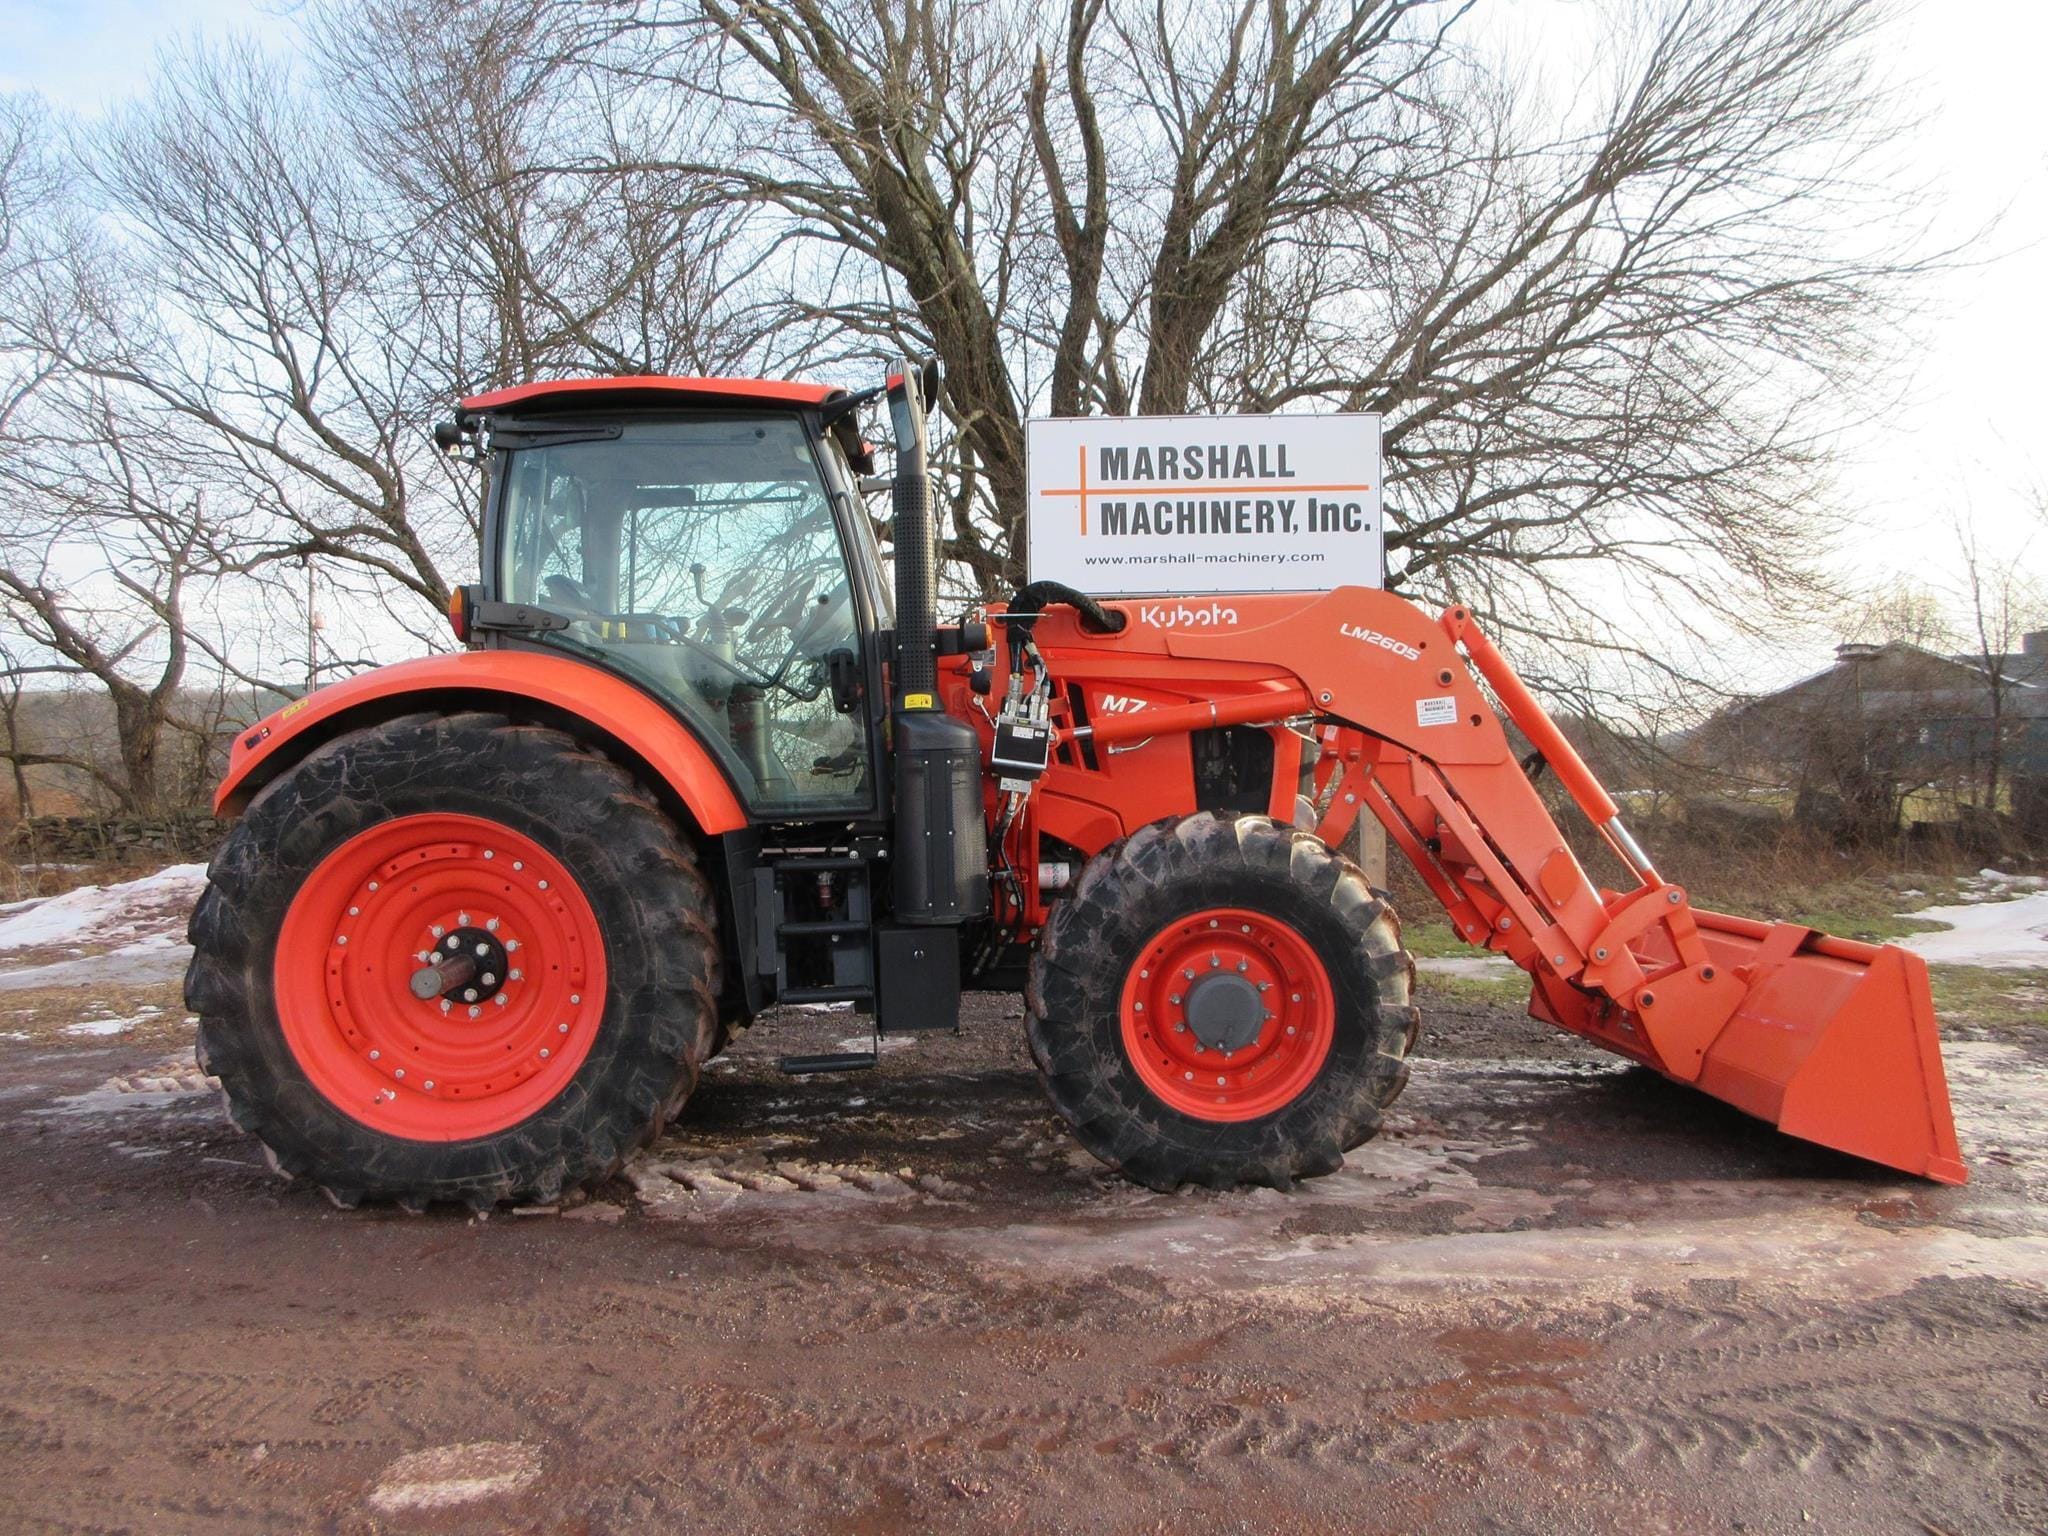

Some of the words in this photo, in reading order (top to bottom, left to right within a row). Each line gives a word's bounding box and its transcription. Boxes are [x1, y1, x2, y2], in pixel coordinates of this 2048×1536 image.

[1100, 444, 1295, 480] MARSHALL
[1100, 500, 1298, 535] MACHINERY,
[1308, 498, 1371, 532] Inc.
[1084, 552, 1325, 565] www.marshall-machinery.com
[1141, 603, 1238, 628] Kubota
[1339, 622, 1421, 661] LM2605
[1101, 694, 1148, 714] M7
